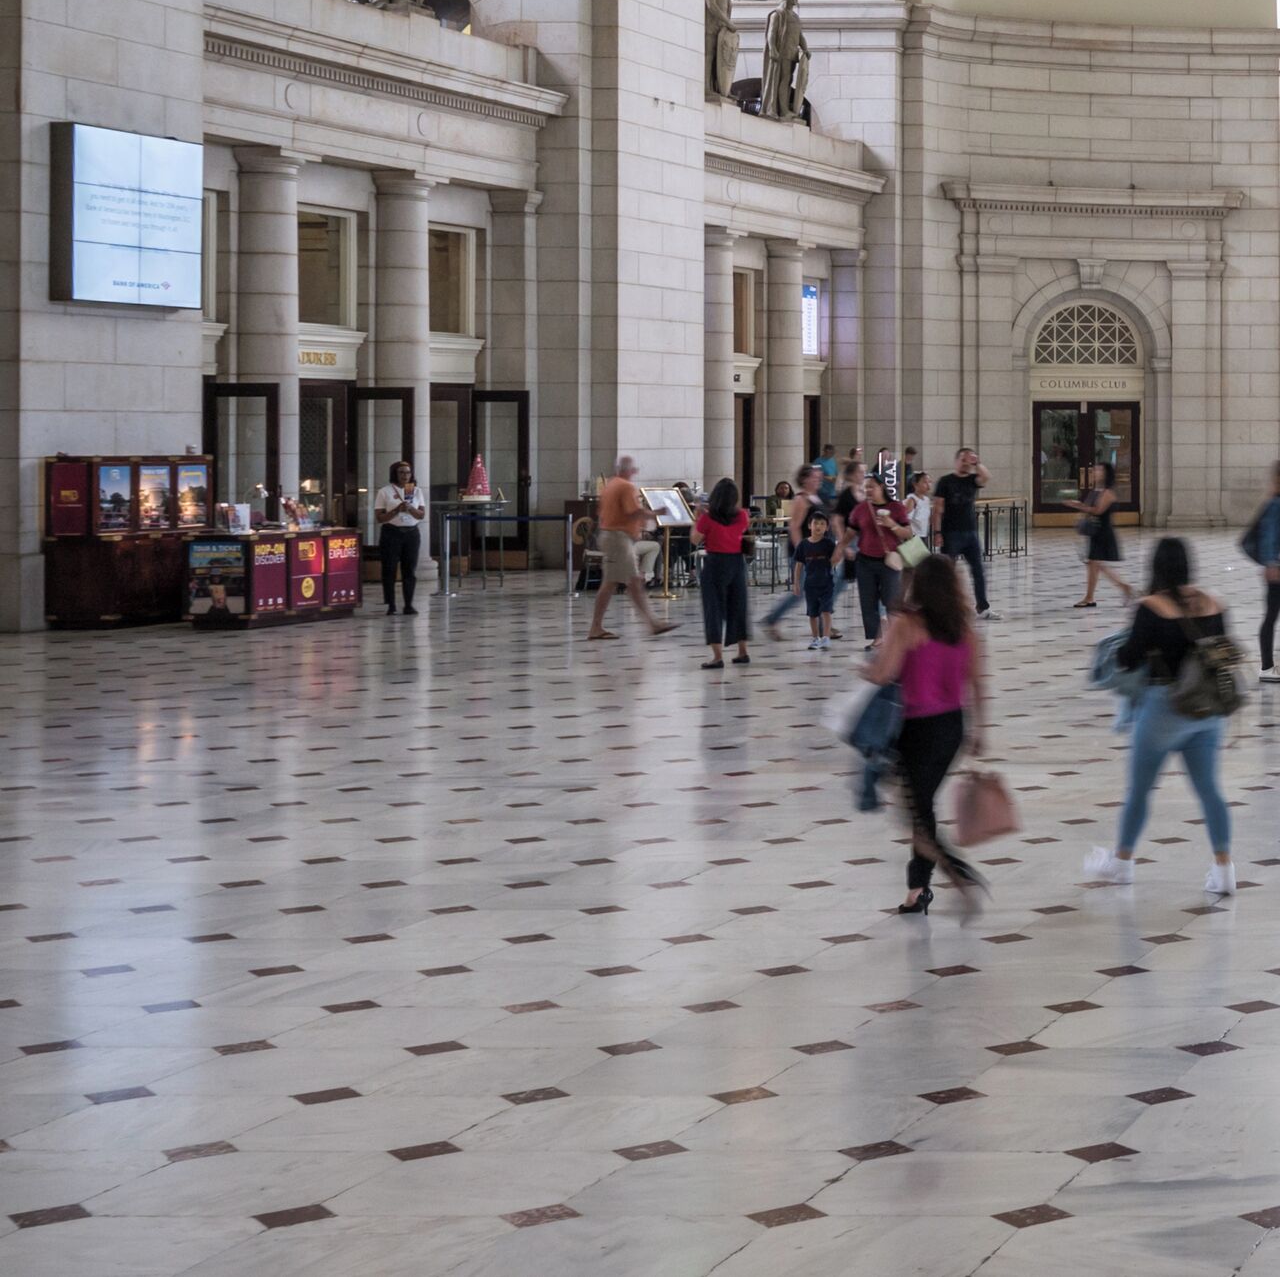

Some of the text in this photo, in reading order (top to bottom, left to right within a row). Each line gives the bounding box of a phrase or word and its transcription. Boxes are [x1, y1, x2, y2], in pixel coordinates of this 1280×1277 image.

[1040, 379, 1127, 389] COLUMBUS CLUB
[255, 543, 285, 555] HOP-ON
